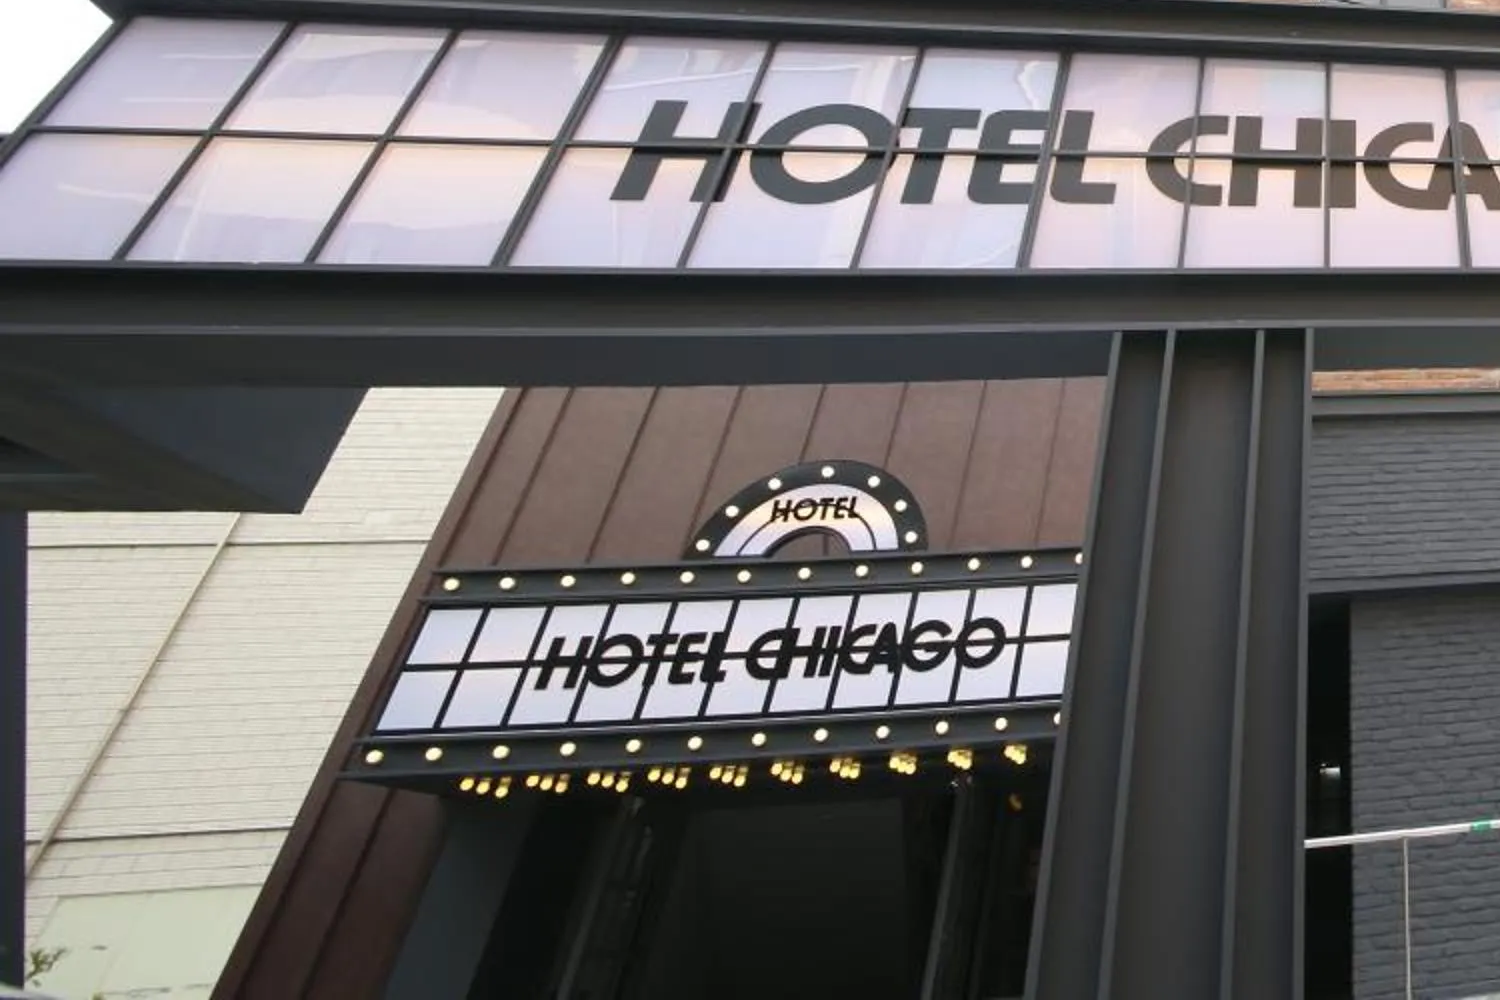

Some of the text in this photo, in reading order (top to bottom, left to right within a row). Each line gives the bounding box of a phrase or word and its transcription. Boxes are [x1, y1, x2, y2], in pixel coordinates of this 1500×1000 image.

[609, 99, 1118, 205] HOTEL
[770, 495, 860, 522] HOTEL
[533, 616, 1007, 690] HOTEL CHICAGO
